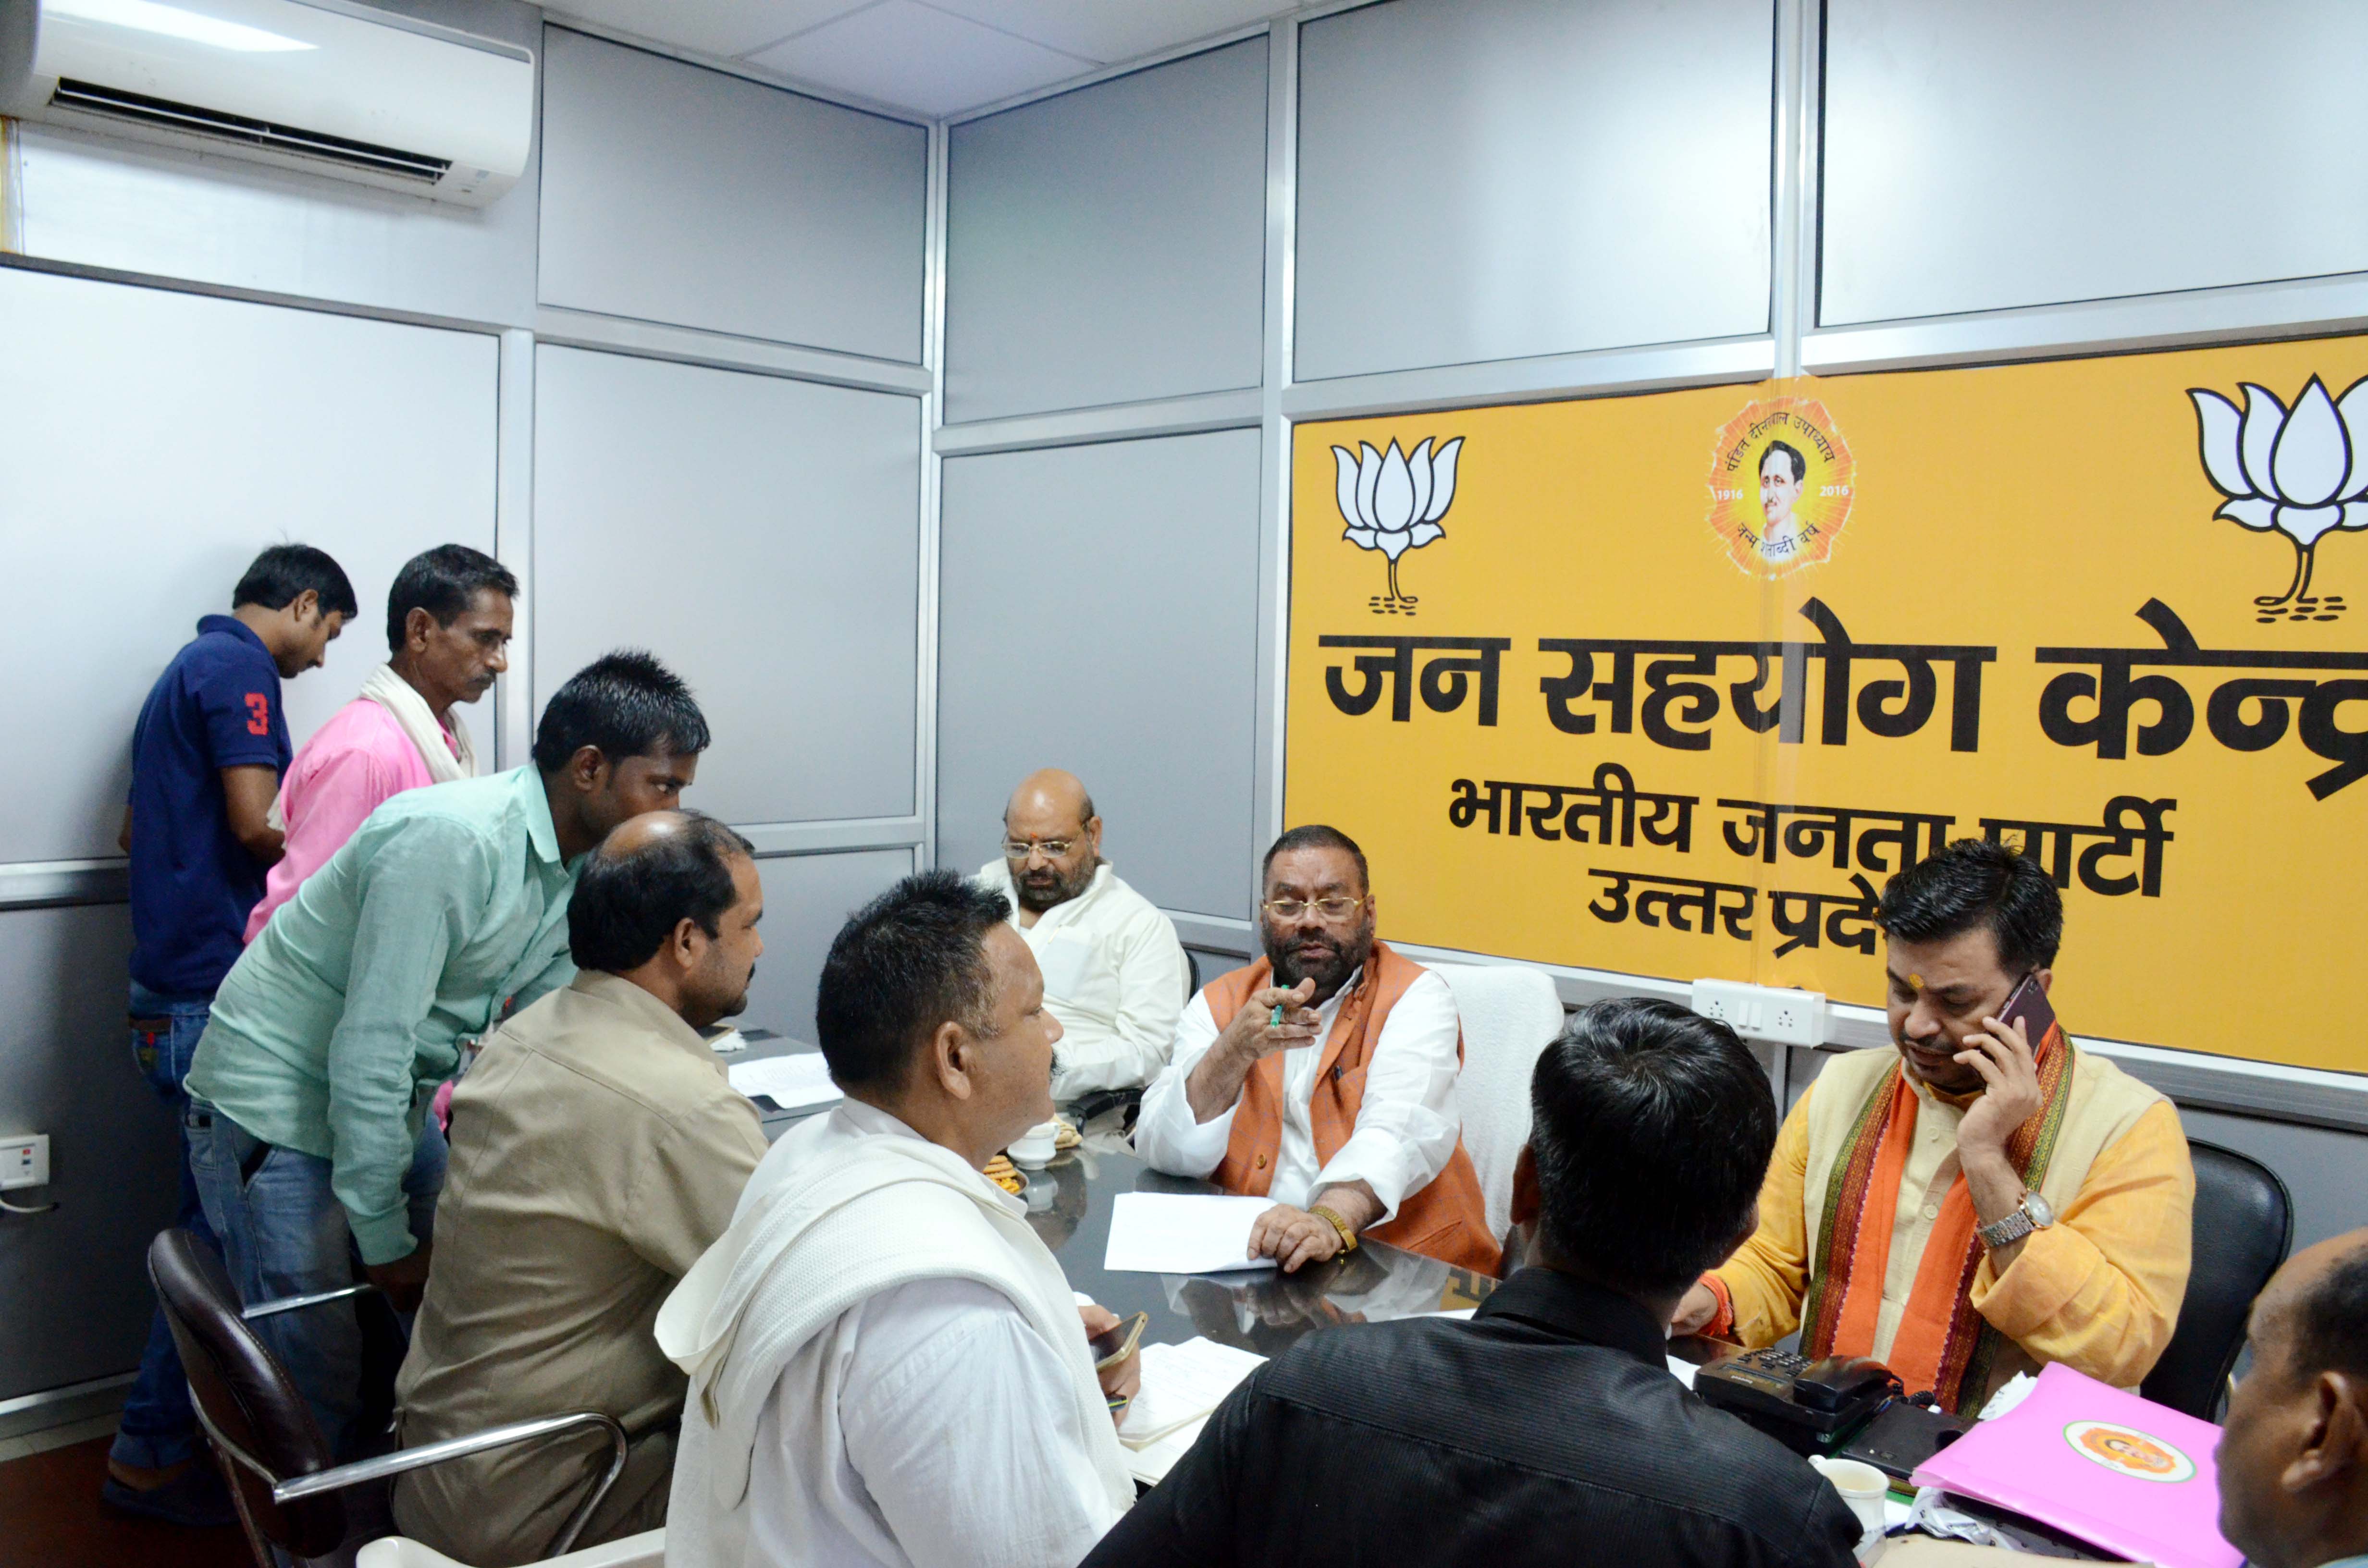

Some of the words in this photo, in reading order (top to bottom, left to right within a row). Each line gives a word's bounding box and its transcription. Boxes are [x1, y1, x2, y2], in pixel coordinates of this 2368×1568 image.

[1725, 438, 1751, 472] पंडित
[1793, 416, 1836, 464] उपाध्याय
[1717, 490, 1744, 501] 1916
[1819, 485, 1850, 497] 2016
[1737, 522, 1760, 549] जन्म
[1798, 521, 1821, 544] वर्ष
[1319, 635, 1511, 727] जन
[1538, 596, 1997, 753] सहयोग
[244, 692, 269, 735] 3
[1449, 762, 1699, 853] भारतीय
[1717, 798, 1956, 873] जनता
[1979, 796, 2177, 897] पार्टी
[1588, 868, 1757, 941] उत्तर
[1768, 872, 1885, 958] प्रदे
